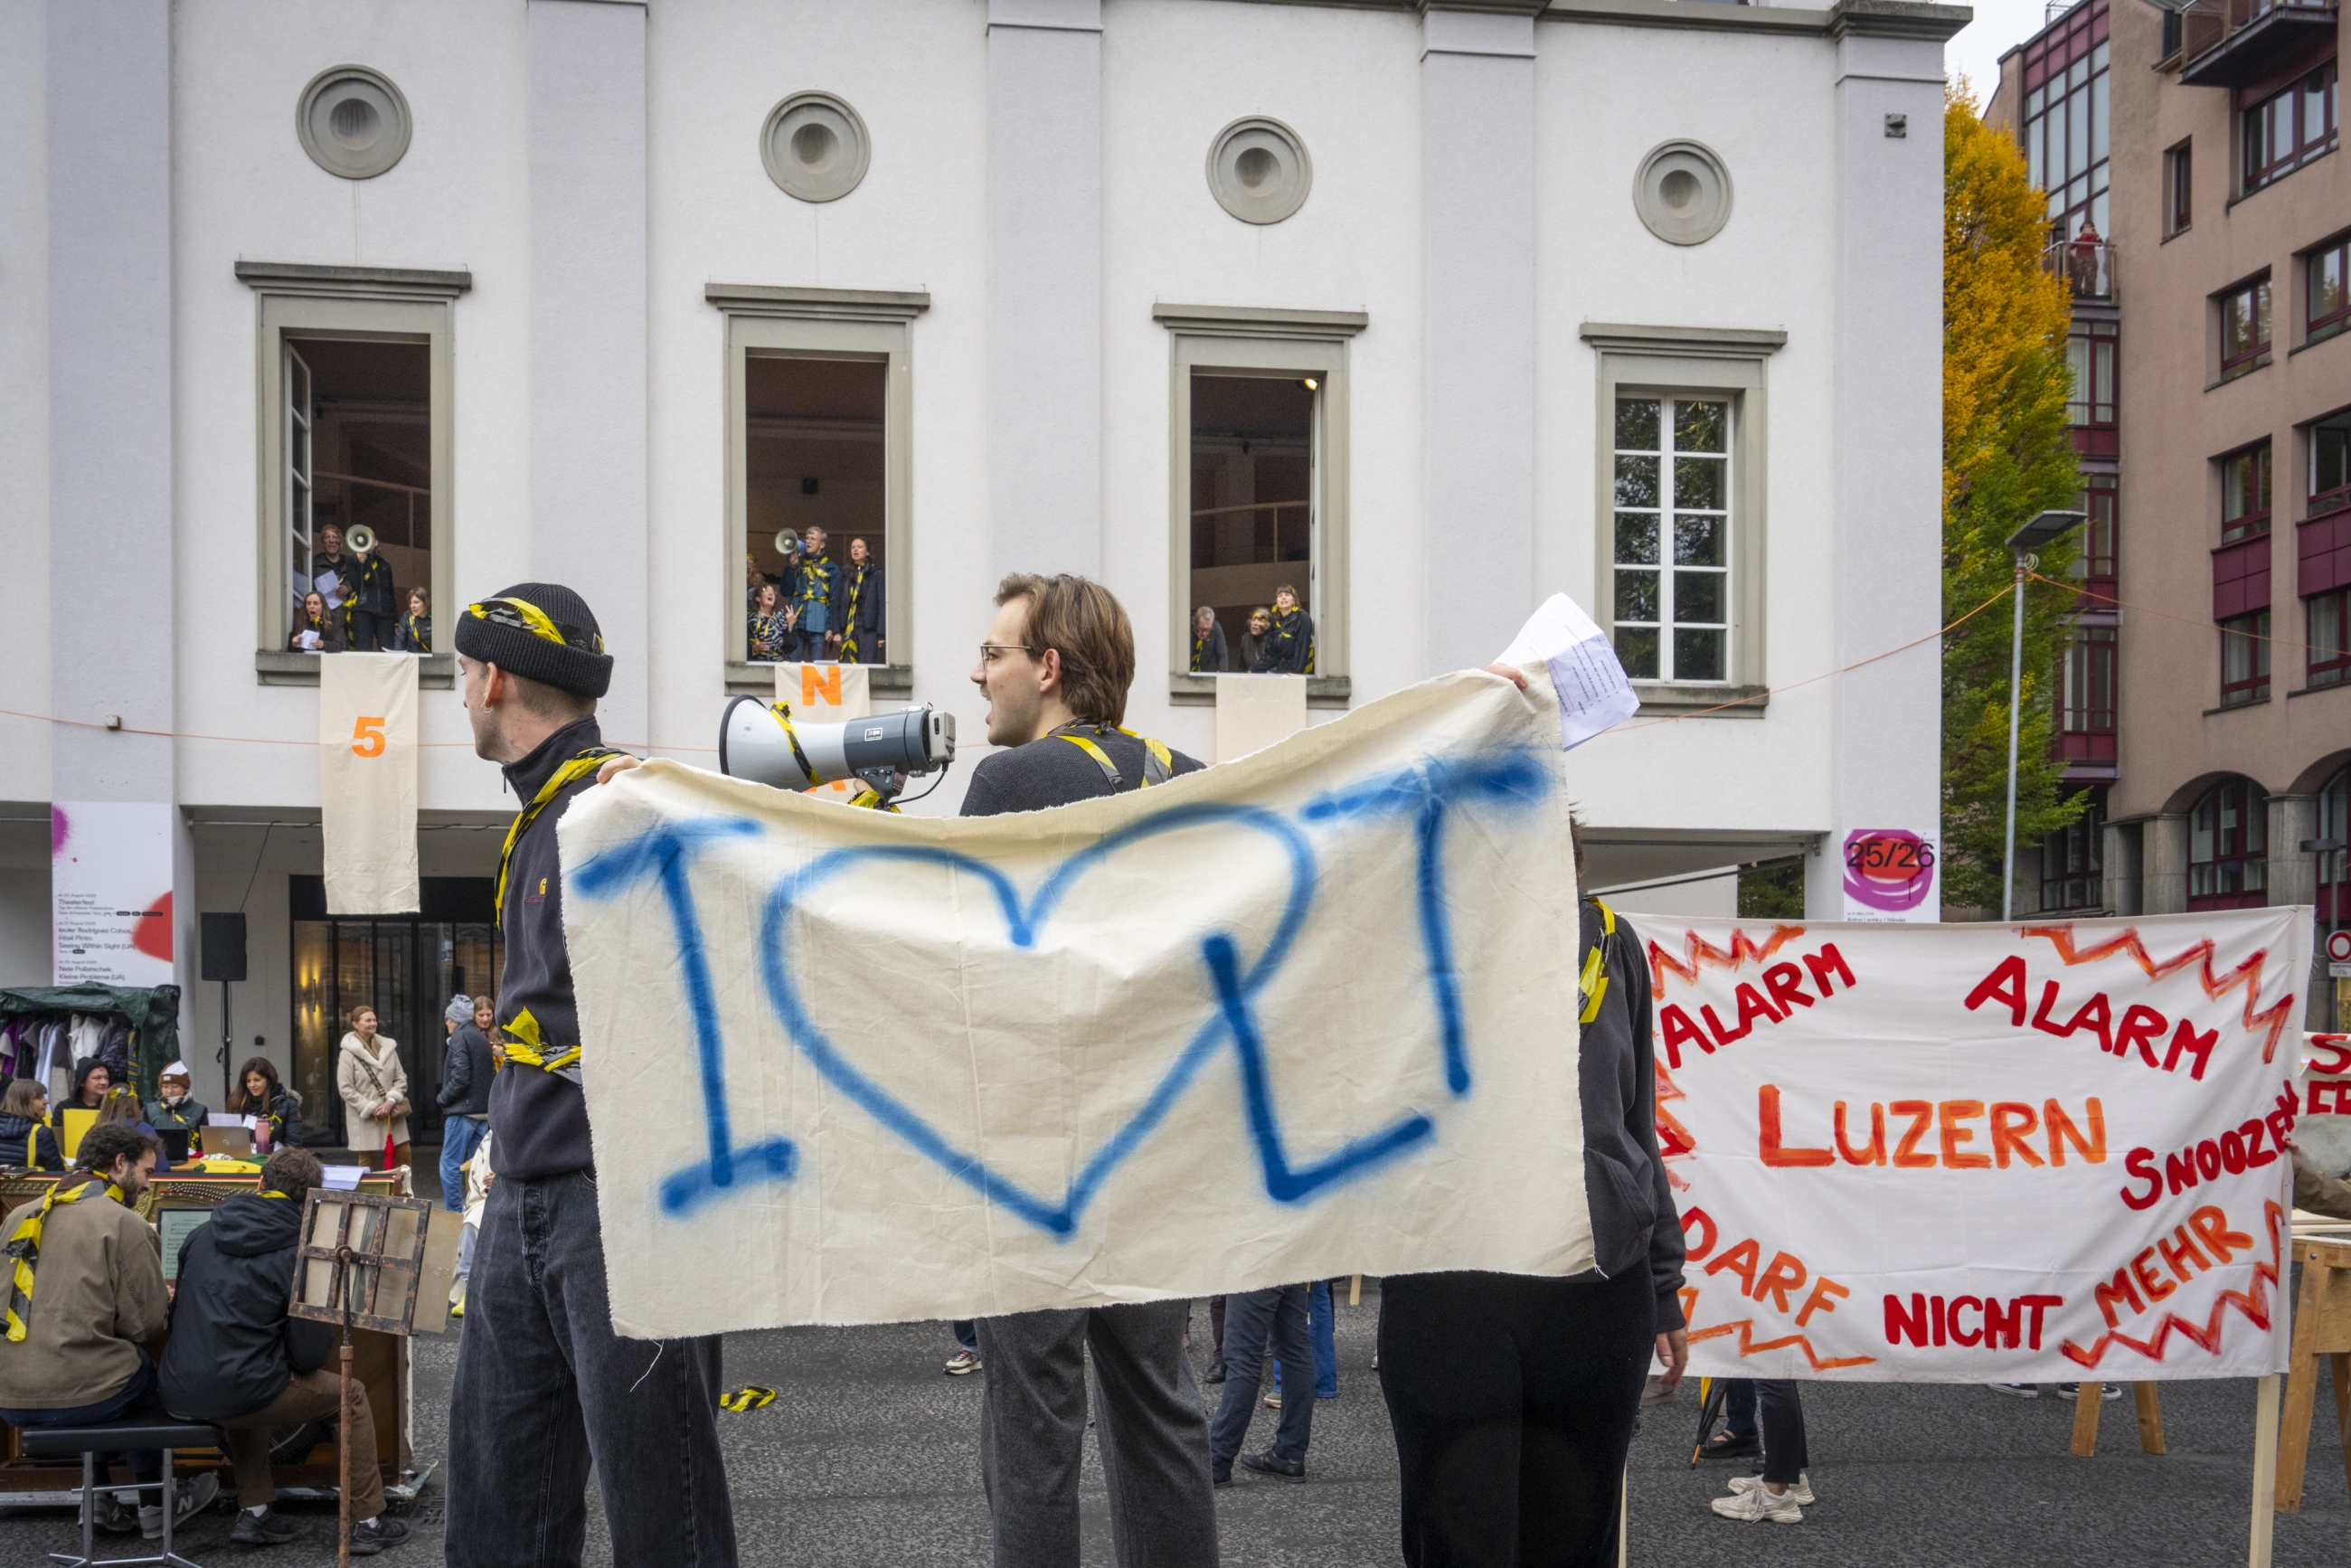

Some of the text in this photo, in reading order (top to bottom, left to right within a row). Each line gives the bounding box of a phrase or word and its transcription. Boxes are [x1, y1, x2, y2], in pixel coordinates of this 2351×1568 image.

[802, 666, 841, 705] N
[352, 716, 385, 758] 5
[1846, 842, 1935, 867] 25/26
[571, 817, 798, 1217] I
[1659, 942, 2219, 1082] ALARM ALARM
[1759, 1084, 2107, 1169] LUZERN
[1679, 1204, 1850, 1327] DARF
[2094, 1204, 2253, 1329] MEHR
